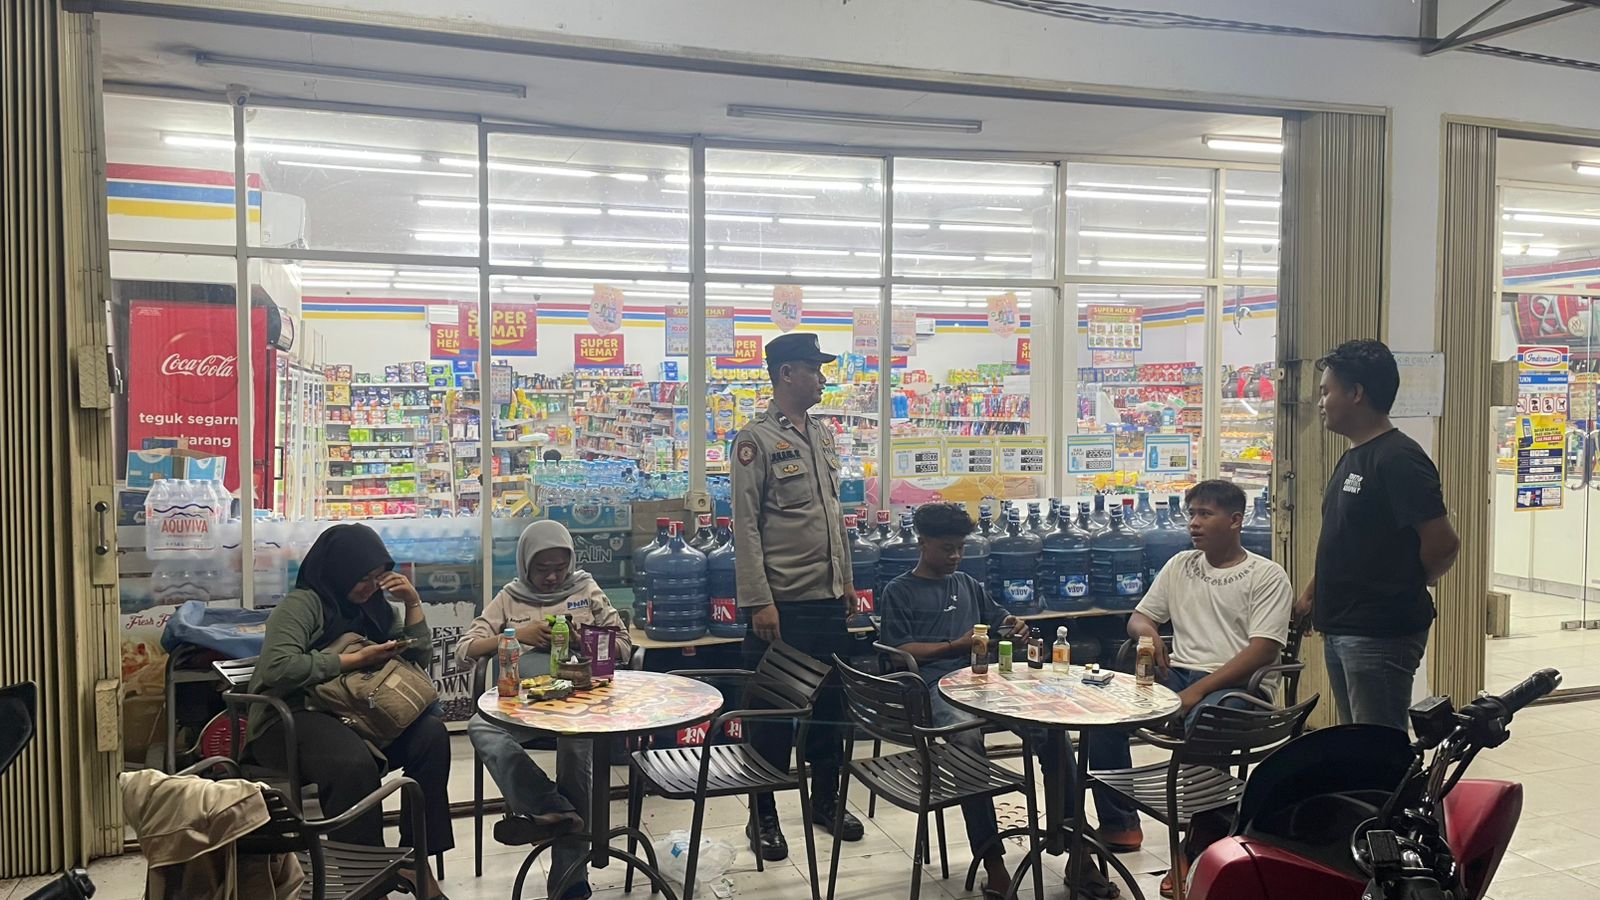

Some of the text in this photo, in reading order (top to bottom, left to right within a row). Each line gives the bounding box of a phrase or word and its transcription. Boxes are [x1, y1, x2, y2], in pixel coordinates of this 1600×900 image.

[467, 309, 527, 325] SPER
[467, 324, 527, 338] HMAT
[580, 338, 619, 349] SUPER
[736, 340, 757, 349] PER
[580, 347, 619, 357] HEMAT
[735, 349, 756, 358] MAT
[1526, 352, 1560, 363] Indomaret
[161, 352, 239, 378] Coca-Cola
[139, 411, 183, 425] teguk
[181, 433, 232, 448] arang
[161, 518, 209, 534] AQUVIVA
[567, 598, 590, 610] PNM
[711, 603, 732, 622] Vit
[126, 614, 155, 630] Fresh
